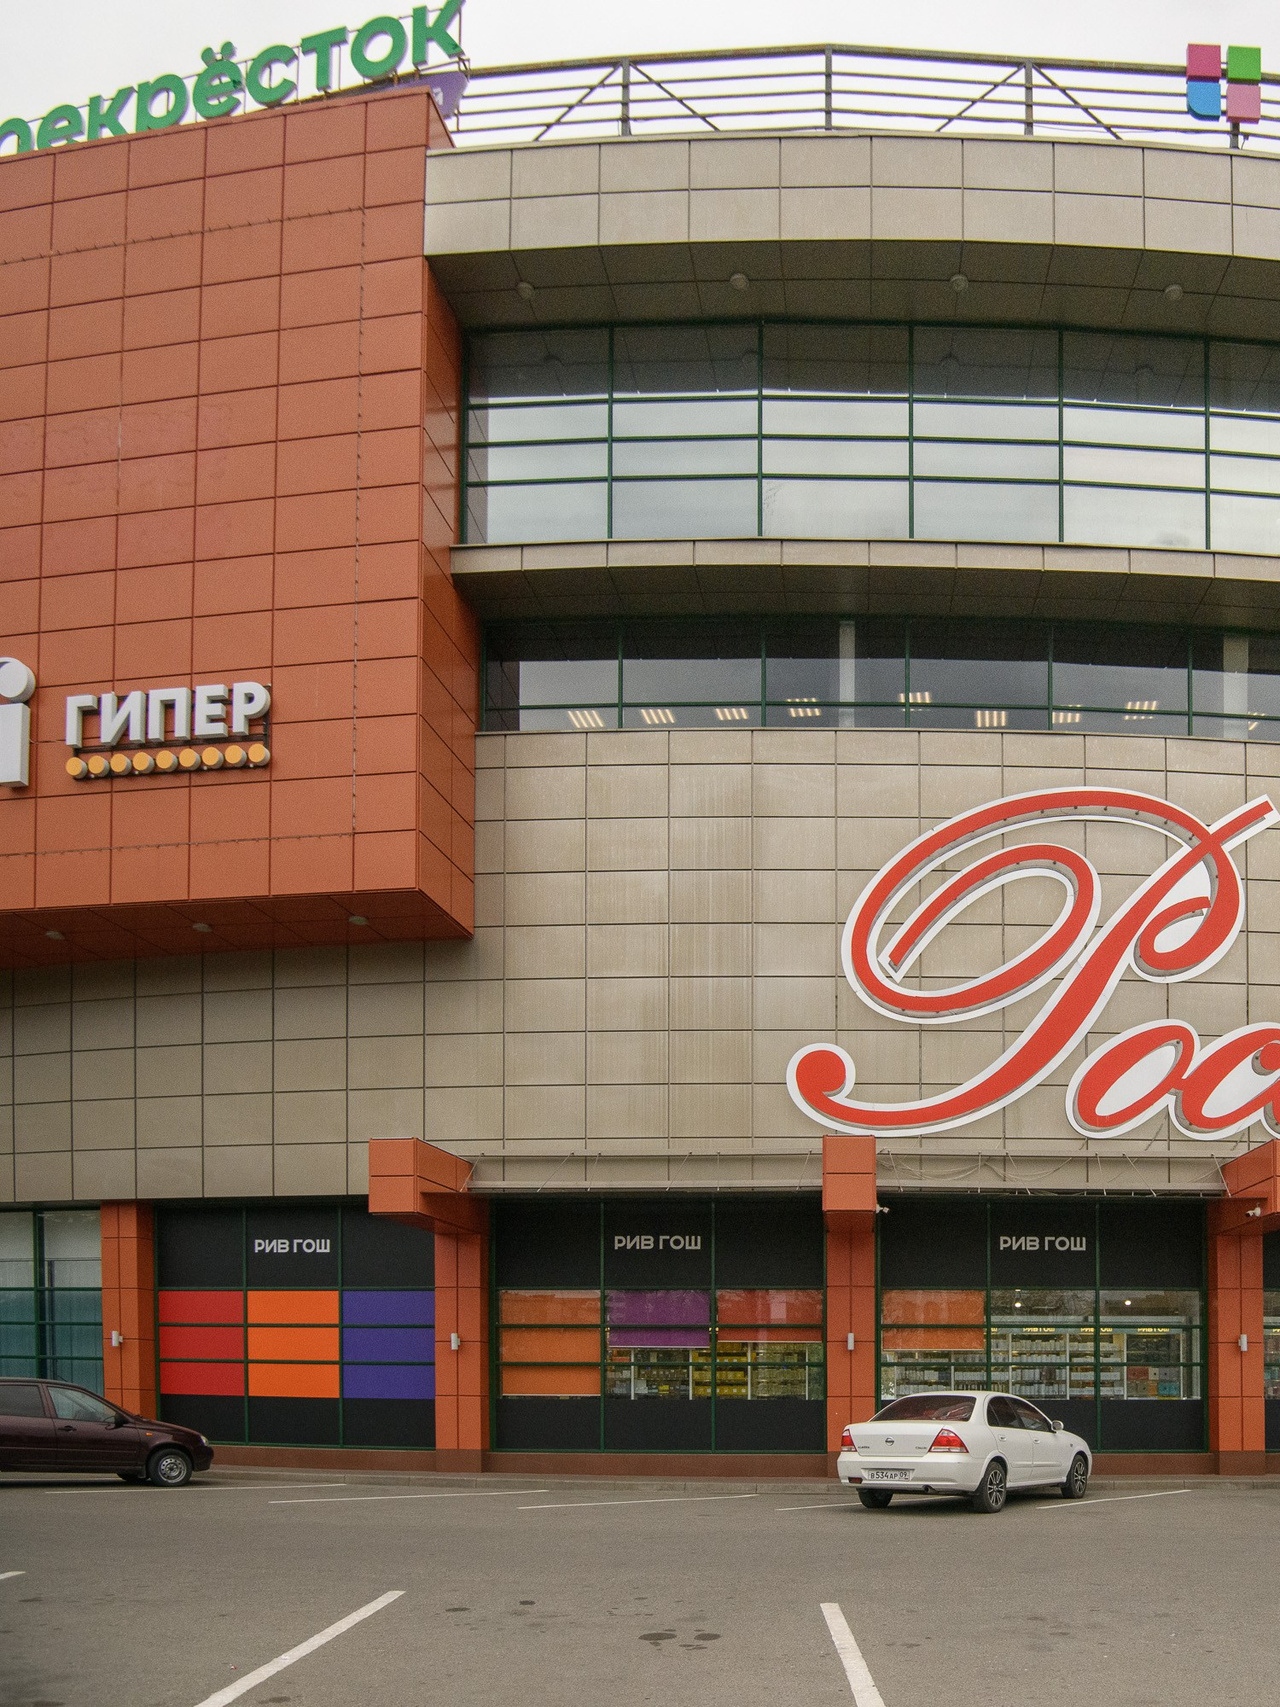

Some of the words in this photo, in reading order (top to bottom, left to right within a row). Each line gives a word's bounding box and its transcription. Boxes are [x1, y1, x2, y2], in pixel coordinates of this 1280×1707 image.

[65, 681, 271, 749] ГИПЕР
[255, 1239, 290, 1253] РИВ
[293, 1239, 331, 1253] ГОШ
[614, 1235, 654, 1250] РИВ
[659, 1235, 702, 1250] ГОШ
[999, 1236, 1040, 1251] РИВ
[1044, 1236, 1087, 1251] ГОШ
